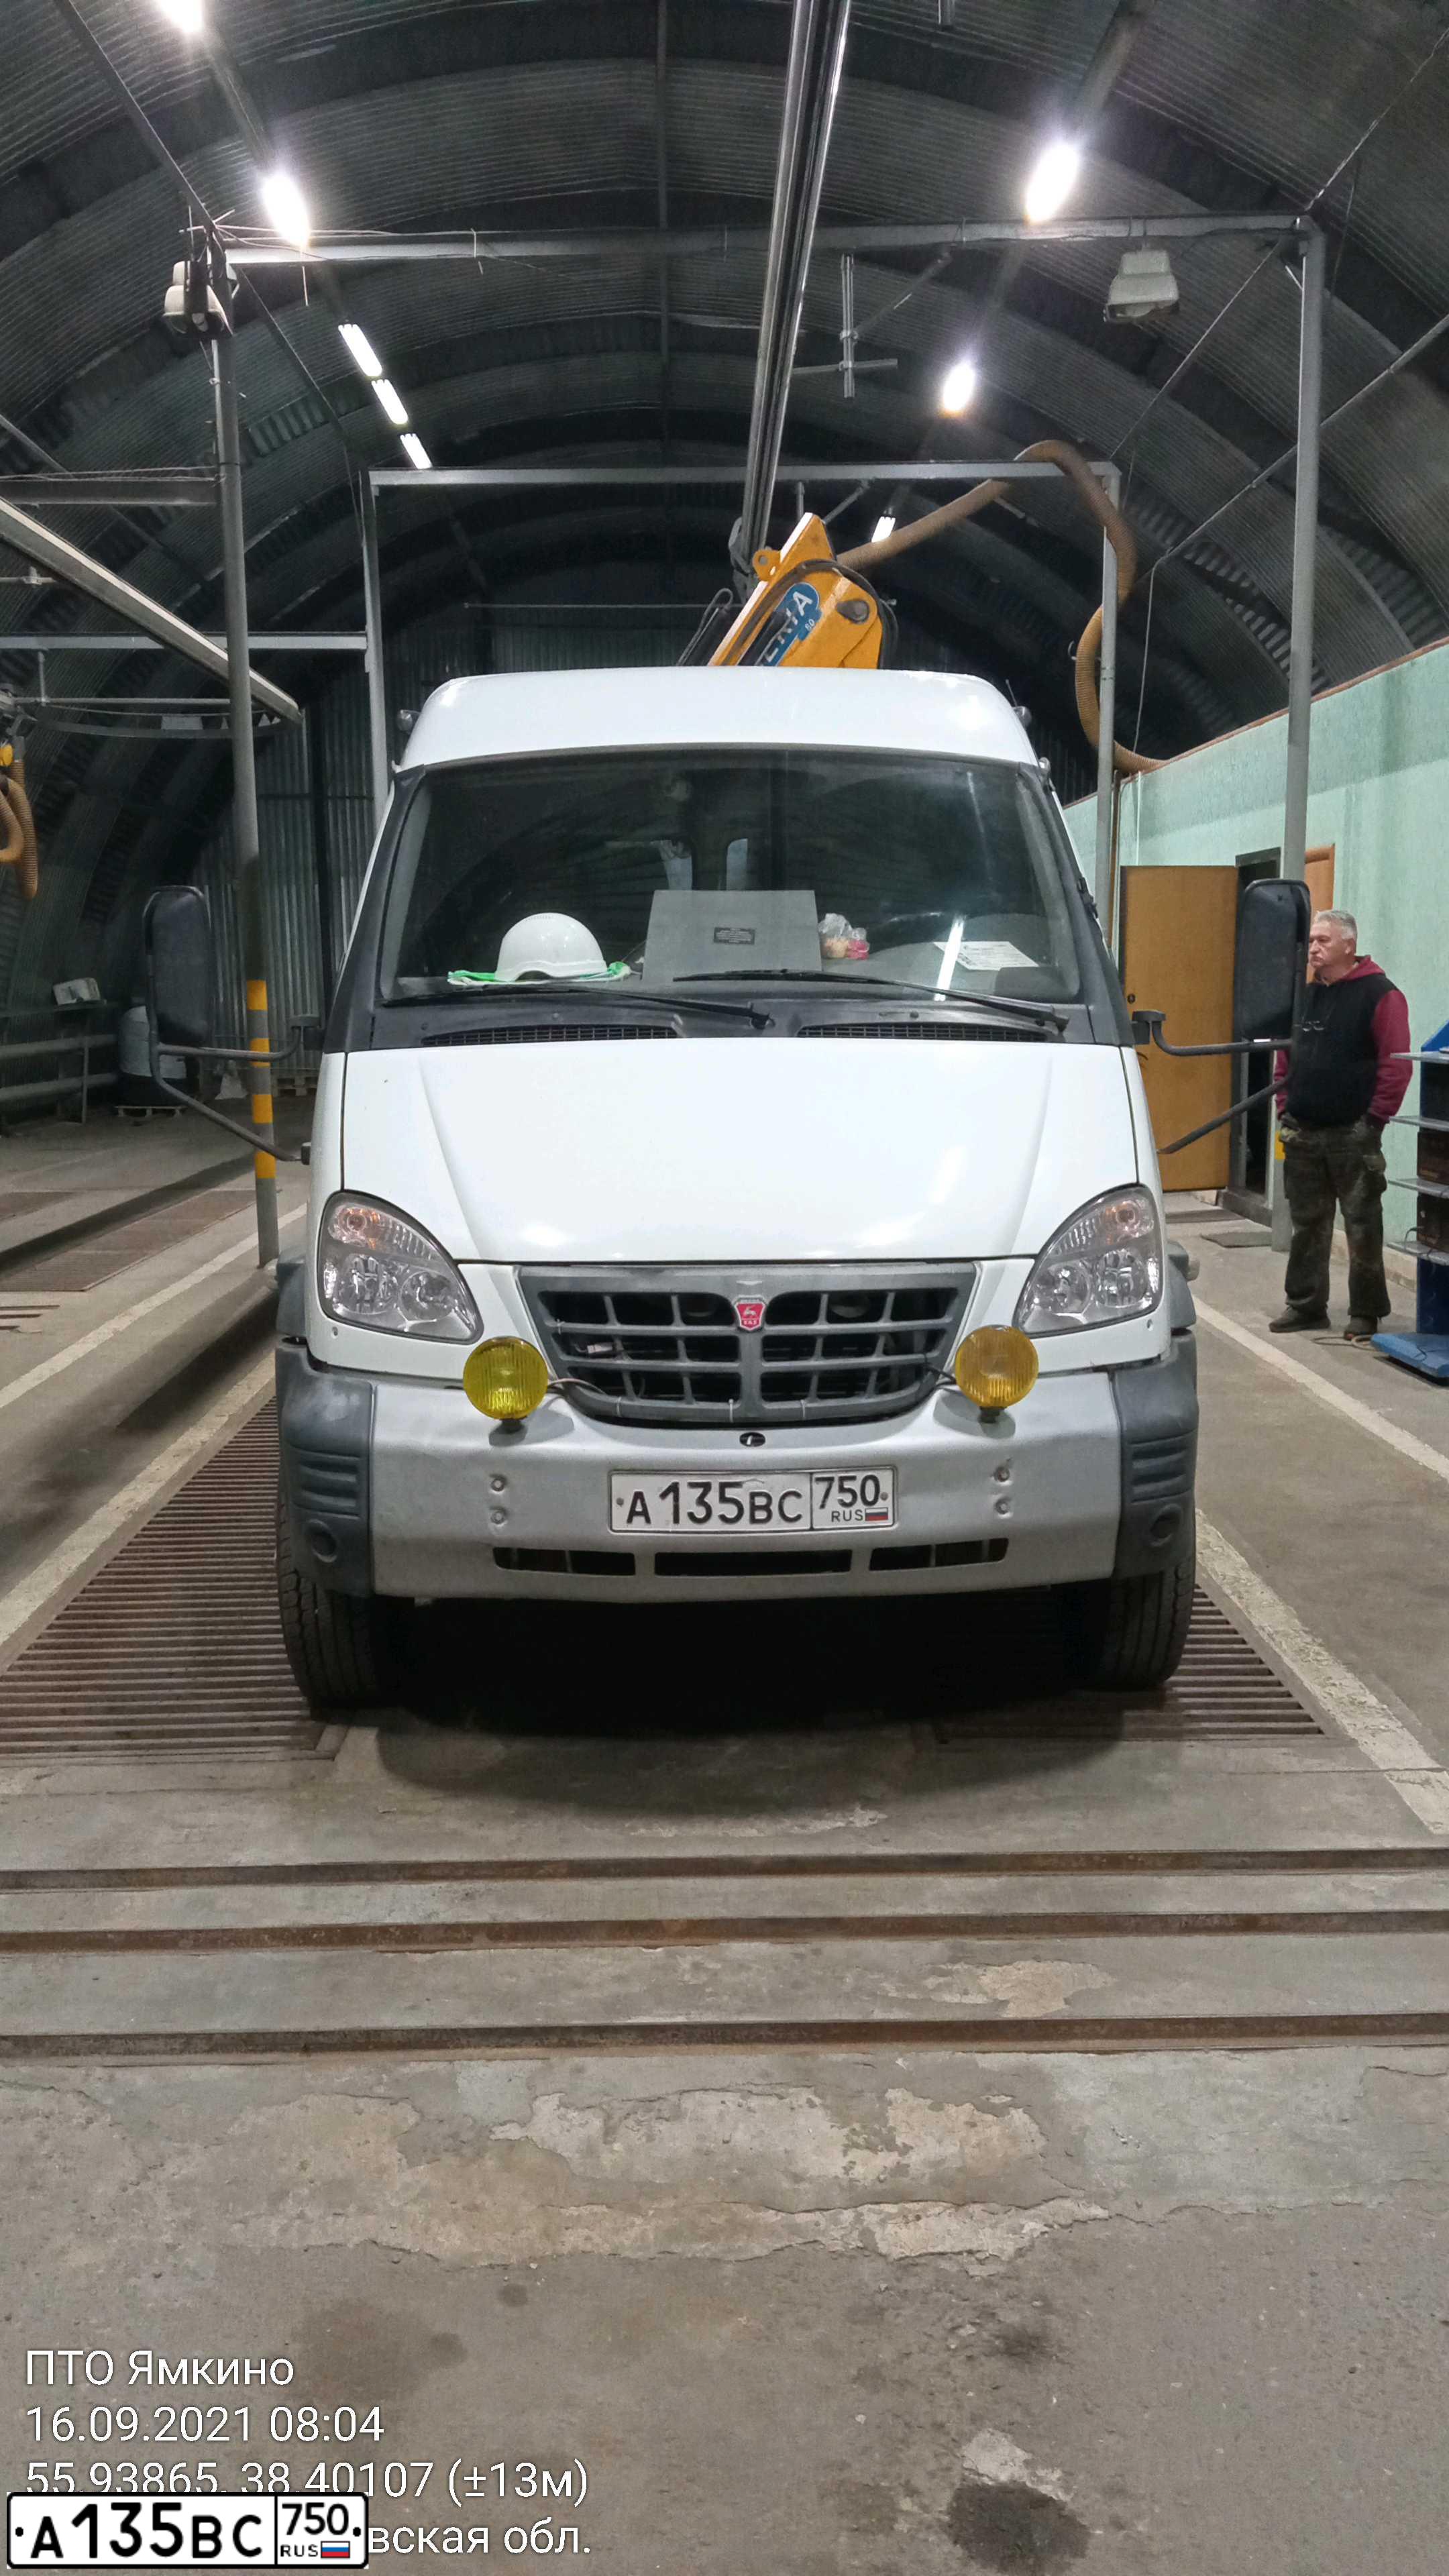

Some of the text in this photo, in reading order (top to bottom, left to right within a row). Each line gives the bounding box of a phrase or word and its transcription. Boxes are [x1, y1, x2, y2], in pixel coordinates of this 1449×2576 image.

[626, 1474, 881, 1525] А135ВС 750
[831, 1509, 863, 1523] RUS
